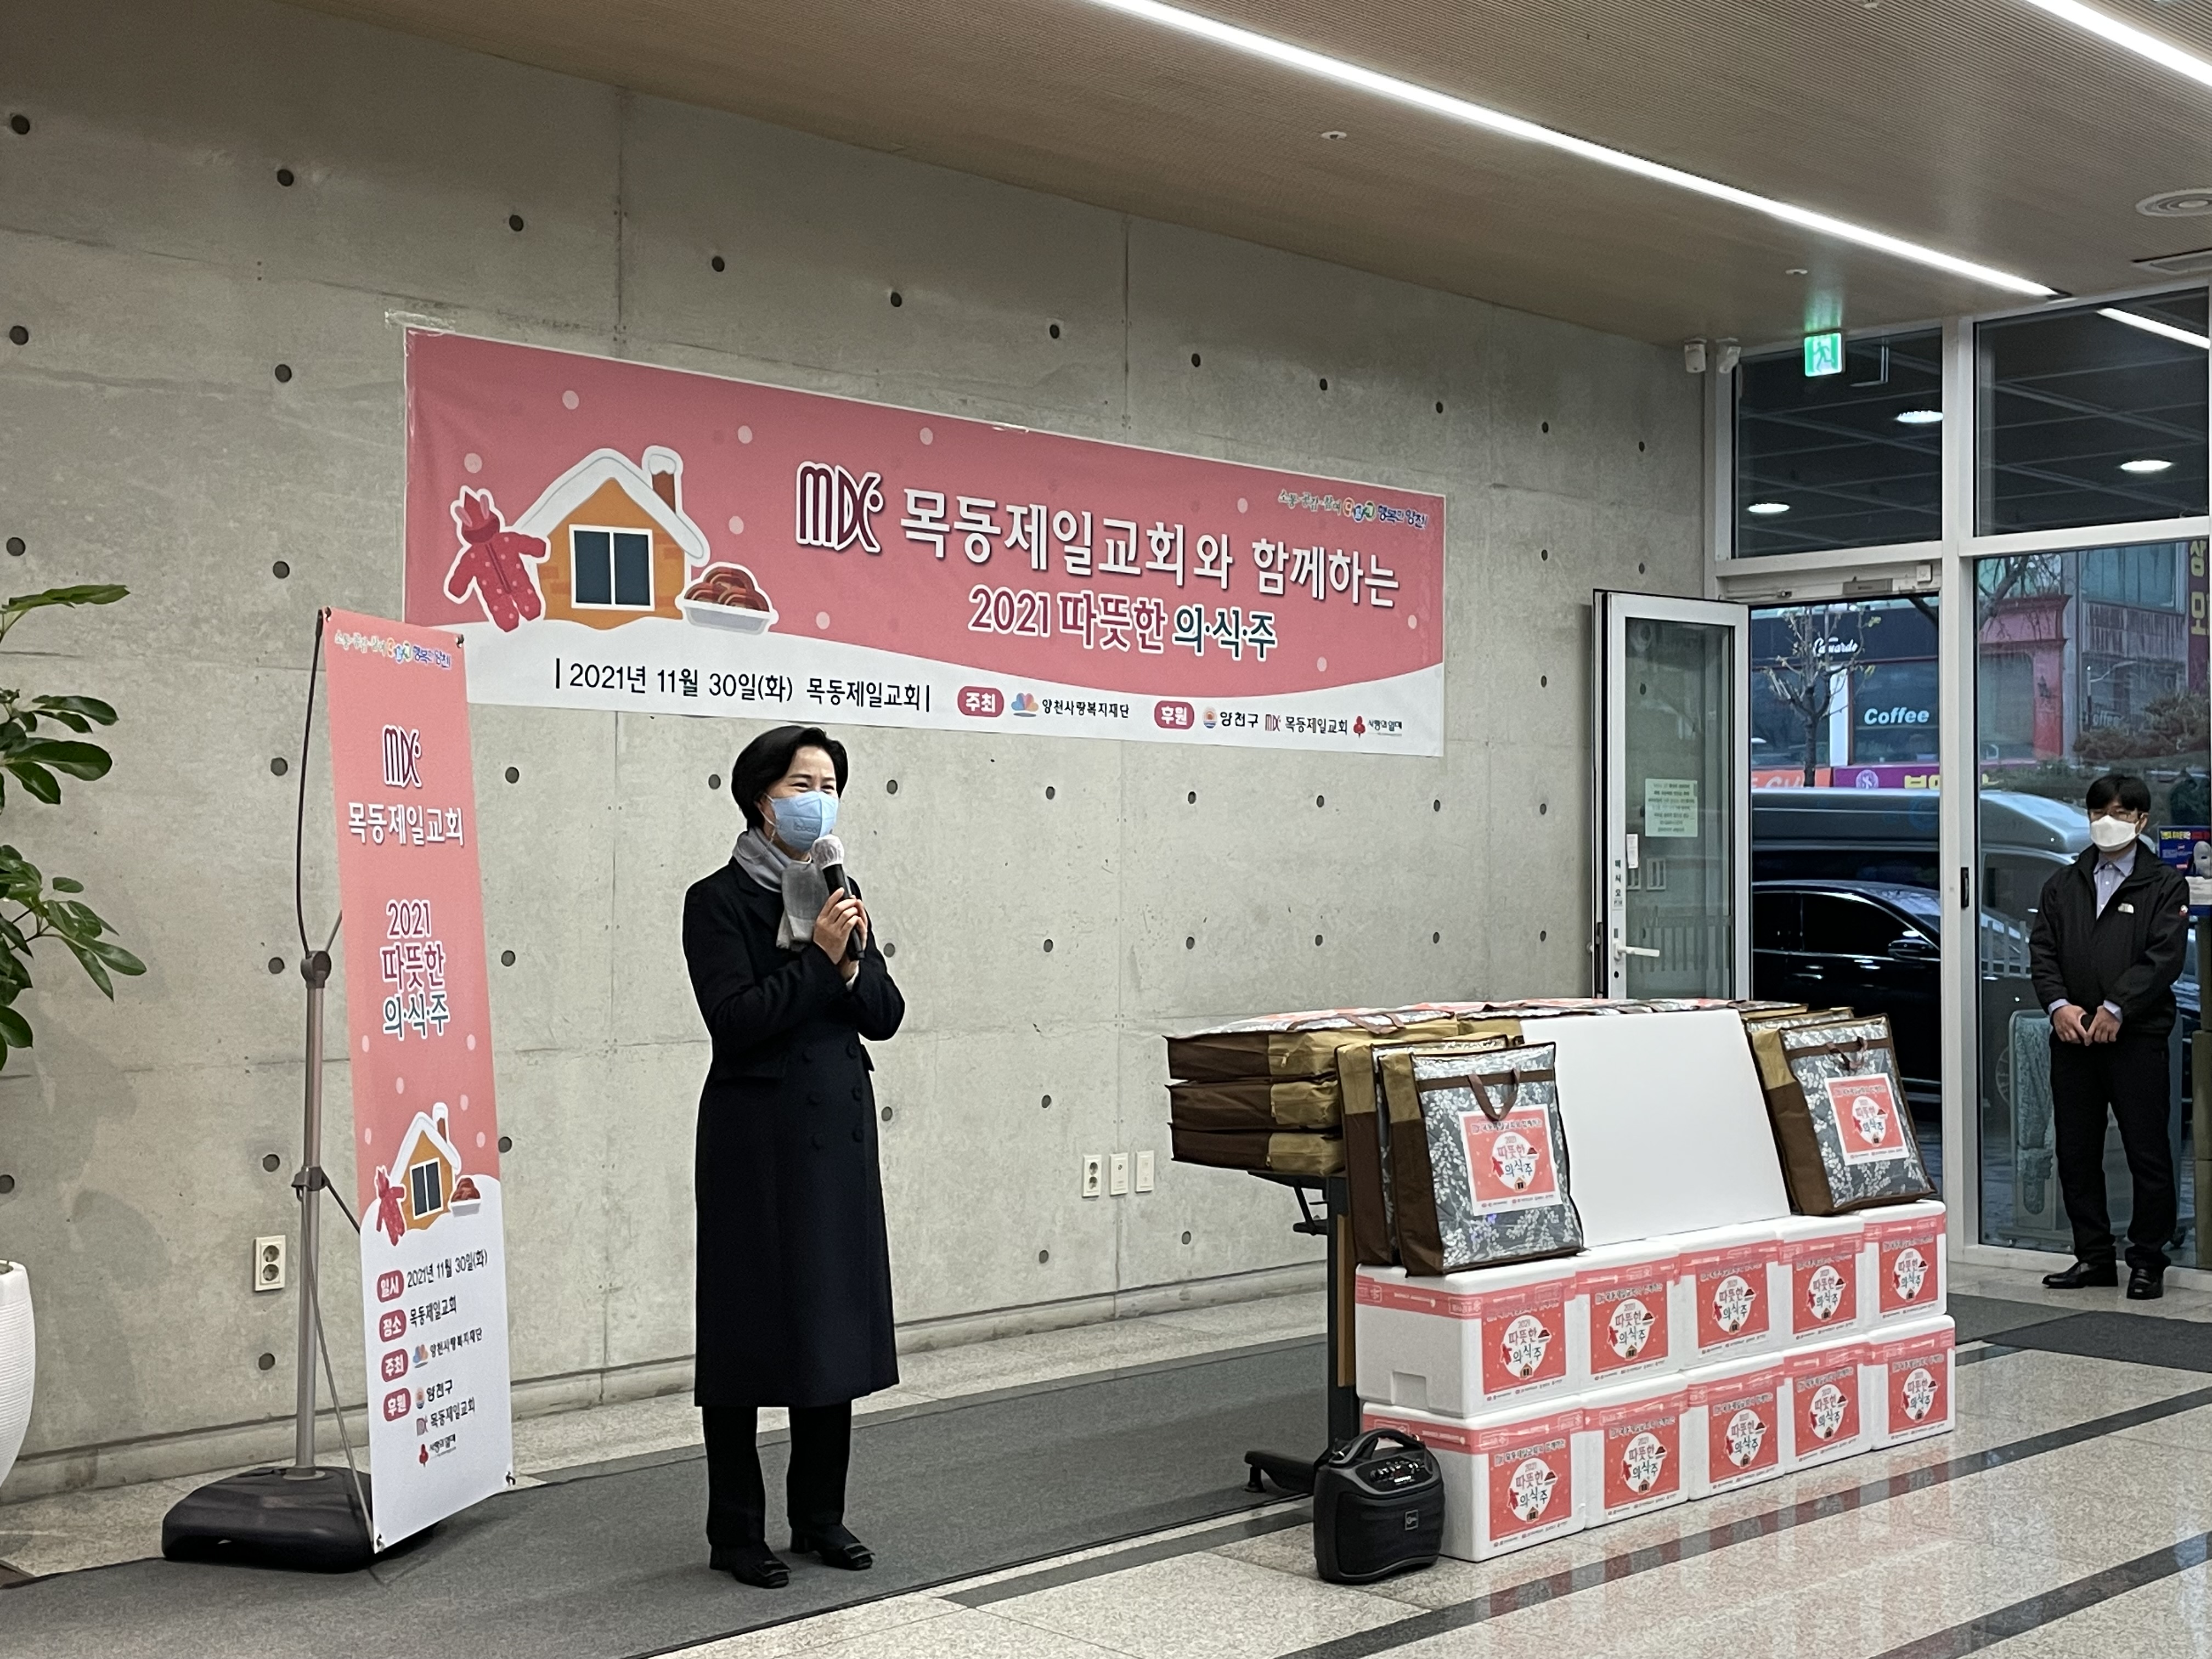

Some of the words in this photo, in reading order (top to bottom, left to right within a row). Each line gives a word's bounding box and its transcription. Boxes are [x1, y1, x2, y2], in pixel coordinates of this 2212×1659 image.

[1252, 538, 1400, 608] 함께하는
[969, 585, 1050, 636] 2021
[1057, 590, 1167, 653] 따뜻한
[569, 663, 647, 694] 2021년
[657, 669, 699, 697] 11월
[709, 673, 793, 703] 30일(화)
[806, 677, 921, 710] 목동제일교회
[965, 691, 996, 713] 주최
[1042, 698, 1130, 719] 양천사랑복지재단
[1161, 706, 1188, 726] 후원
[1220, 711, 1259, 728] 양천구
[1285, 716, 1348, 735] 목동제일교회
[1864, 707, 1929, 725] Coffee
[348, 802, 465, 847] 목동제일교회
[387, 900, 431, 938] 2021
[380, 941, 446, 992] 따뜻한
[407, 1263, 434, 1288] 2021년
[437, 1258, 452, 1278] 11월
[380, 1276, 399, 1298] 일시
[410, 1295, 457, 1328] 목동제일교회
[383, 1315, 402, 1338] 장소
[385, 1353, 404, 1376] 주최
[387, 1393, 407, 1416] 후원
[431, 1396, 476, 1428] 목동제일교회
